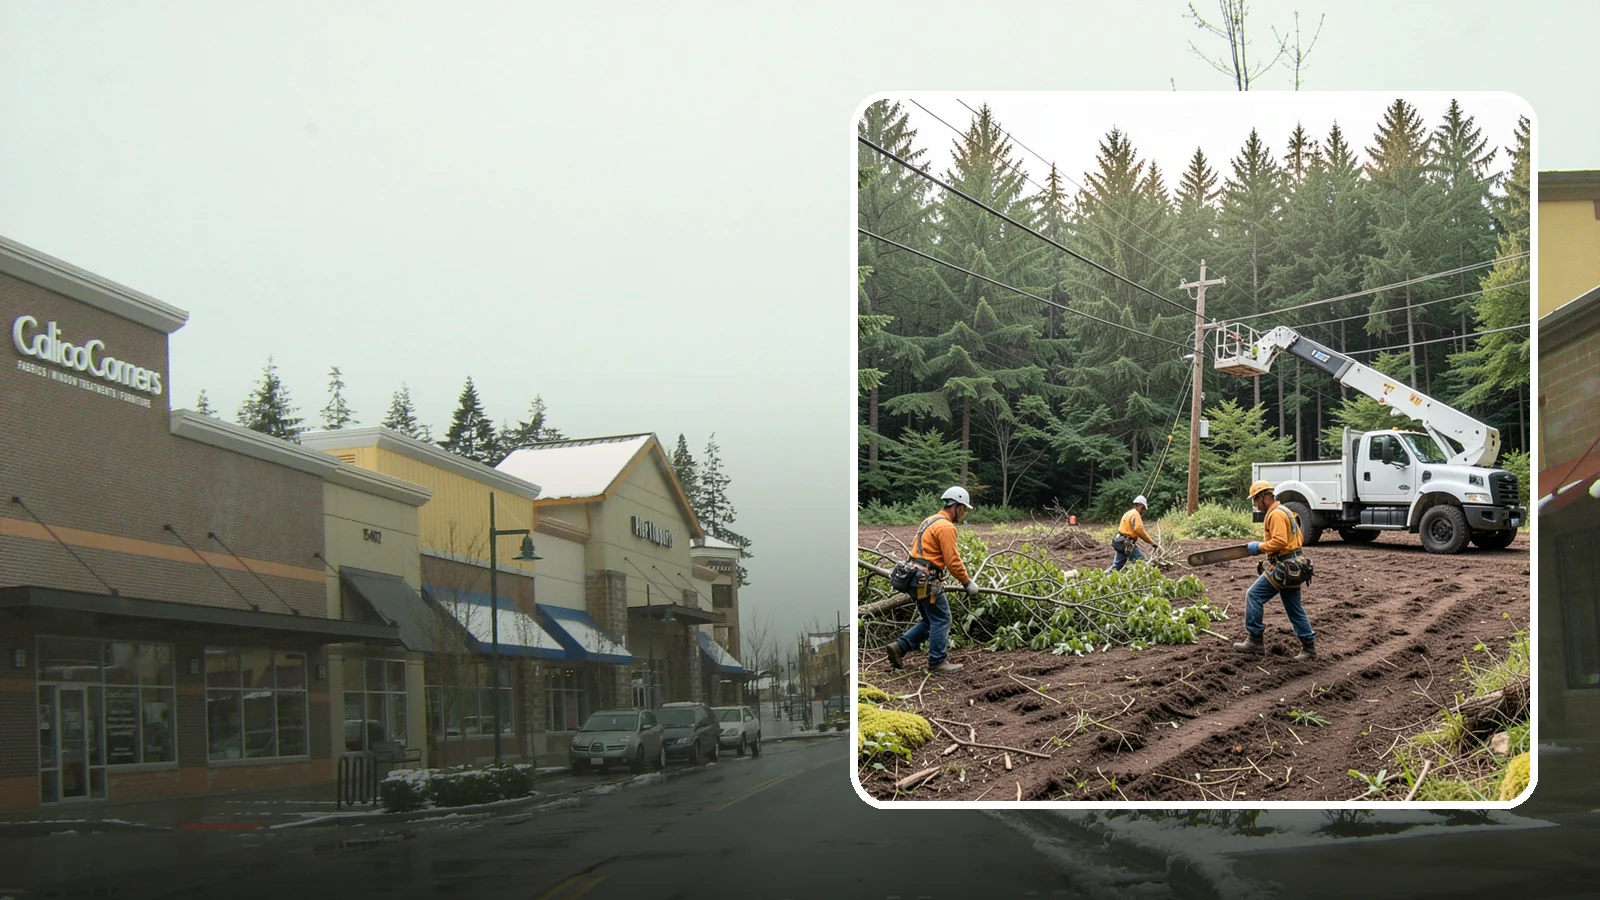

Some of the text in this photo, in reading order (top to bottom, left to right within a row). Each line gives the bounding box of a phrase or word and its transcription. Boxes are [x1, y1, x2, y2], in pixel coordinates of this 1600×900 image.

[17, 360, 152, 408] FABRICS WINDOW TREATMENTS FURNITURE
